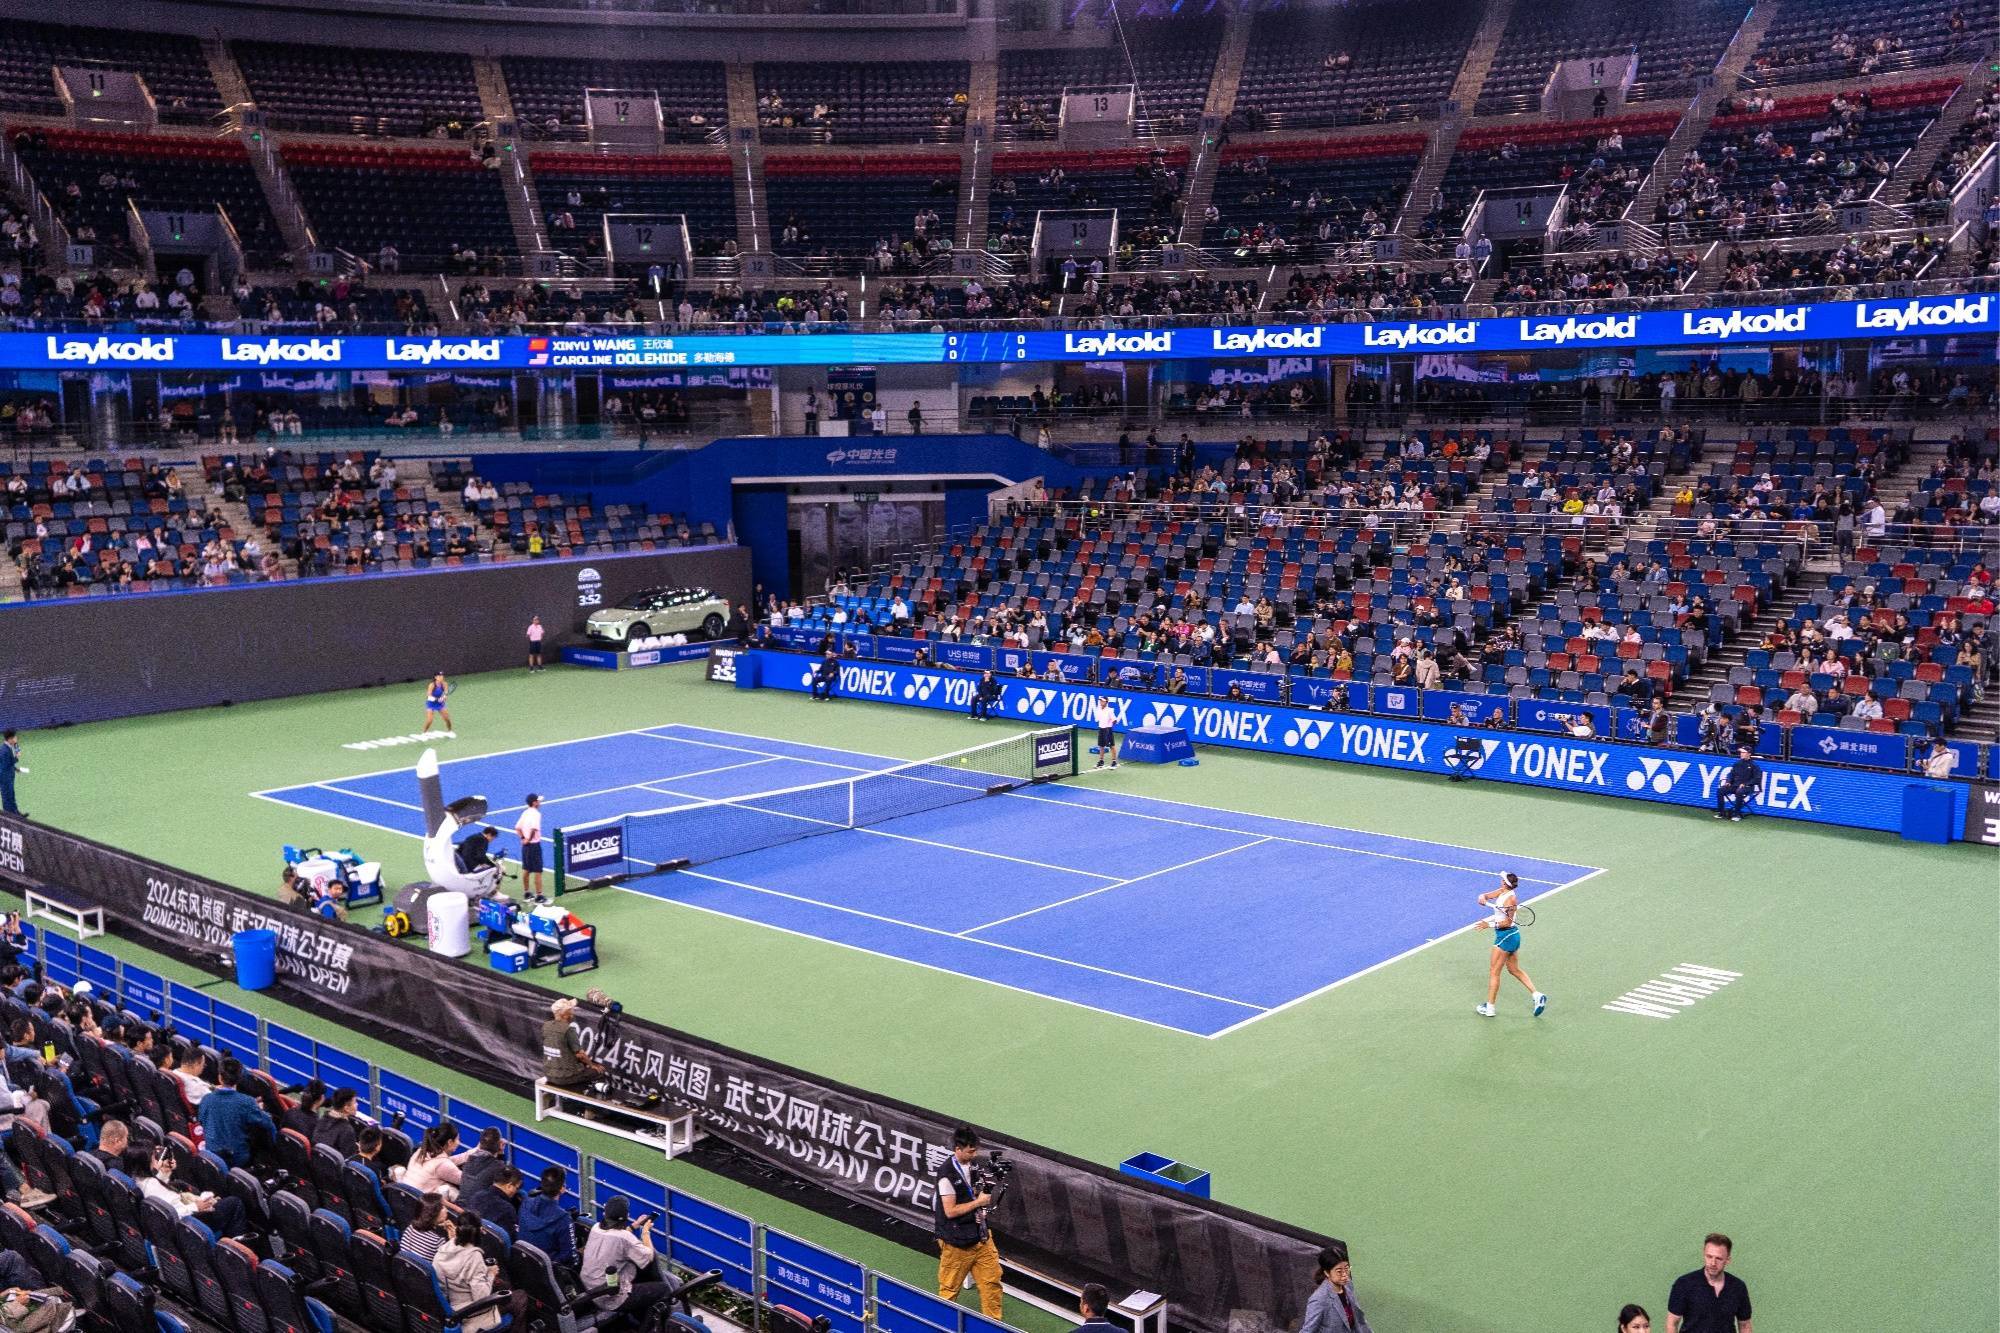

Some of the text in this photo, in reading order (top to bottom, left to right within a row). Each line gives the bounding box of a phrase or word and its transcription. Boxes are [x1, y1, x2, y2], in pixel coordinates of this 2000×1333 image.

[1590, 62, 1604, 77] 14
[90, 74, 104, 89] 11
[615, 102, 629, 115] 12
[1094, 97, 1108, 111] 13
[1516, 201, 1531, 218] 14
[1850, 211, 1862, 224] 15
[168, 217, 184, 233] 11
[1072, 223, 1087, 238] 13
[637, 228, 652, 243] 12
[1606, 231, 1618, 242] 14
[1382, 245, 1393, 255] 14
[1168, 253, 1180, 264] 13
[1450, 308, 1460, 320] 14
[1856, 296, 1989, 331] Laykold
[1520, 315, 1636, 344] Laykold
[1683, 307, 1806, 338] Laykold
[949, 335, 1025, 345] 0 0
[1213, 326, 1321, 353] Laykold
[1364, 321, 1476, 349] Laykold
[47, 336, 174, 364] Laykold
[221, 338, 341, 365] Laykold
[553, 341, 590, 350] XINYU
[593, 339, 635, 351] WANG
[1065, 331, 1171, 356] Laykold
[386, 339, 500, 365] Laykold
[553, 355, 612, 365] CAROLINE
[615, 352, 687, 365] DOLEHIDE
[949, 349, 1025, 359] 0 0
[847, 448, 897, 460] 中国光谷
[578, 593, 602, 606] 3:52
[839, 666, 897, 697] YONEX
[1192, 706, 1272, 744] YONEX
[1038, 740, 1069, 755] HOLOGIC
[1339, 722, 1429, 764] YONEX
[1507, 742, 1609, 785] YONEX
[571, 834, 621, 855] HOLOGIC
[143, 903, 201, 938] DONGFENG
[308, 963, 351, 995] OPEN
[1600, 962, 1744, 1019] WUHAN
[873, 1165, 937, 1212] OPE
[777, 1266, 810, 1288] 请勿走动
